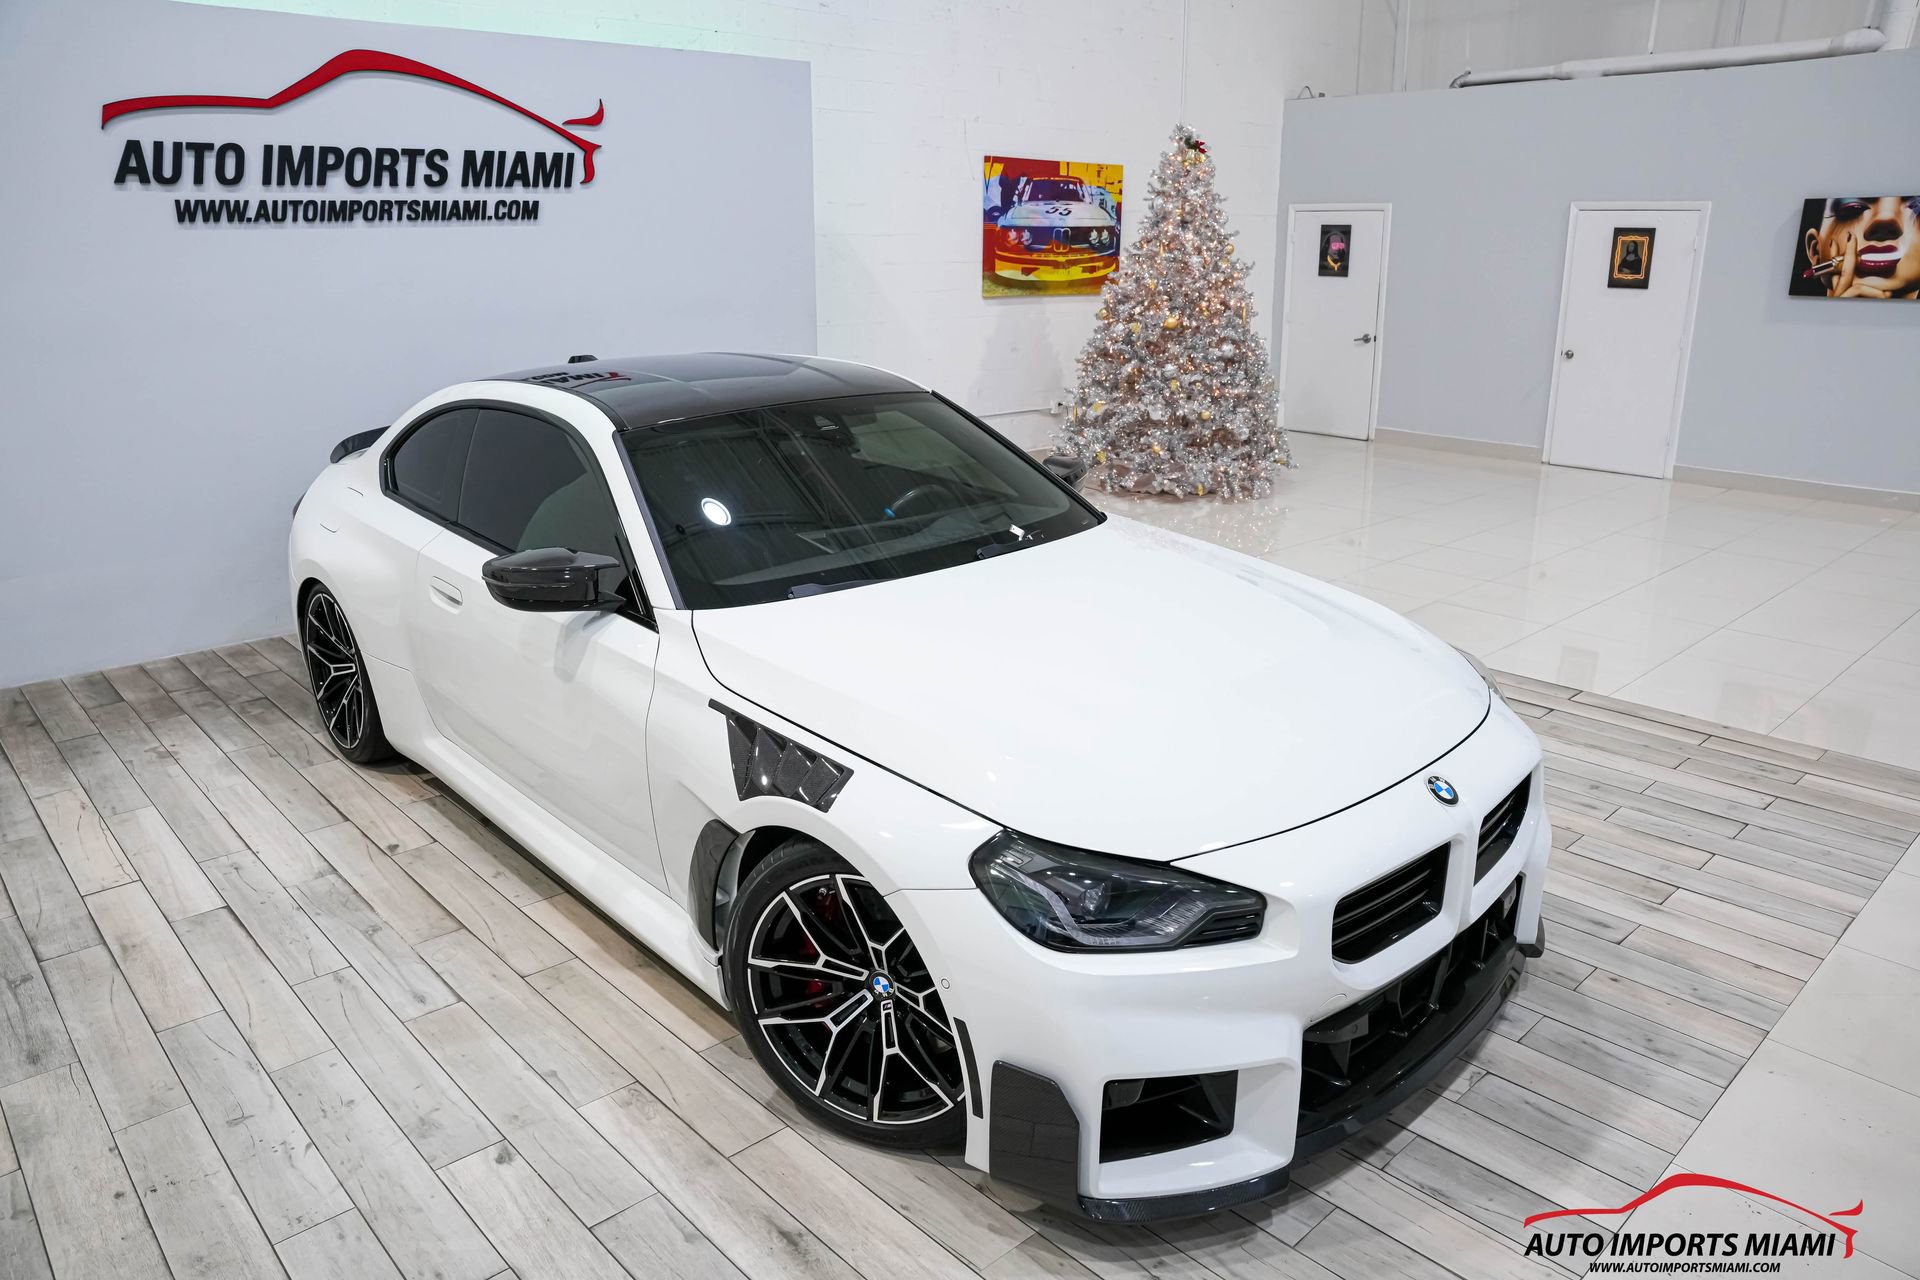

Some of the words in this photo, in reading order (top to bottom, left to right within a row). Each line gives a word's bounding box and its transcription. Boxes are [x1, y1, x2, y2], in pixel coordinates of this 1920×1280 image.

[113, 139, 245, 186] AUTO
[261, 144, 449, 188] IMPORTS
[461, 149, 575, 188] MIAMI
[174, 199, 540, 224] WWW.AUTOIMPORTSMIAMI.COM
